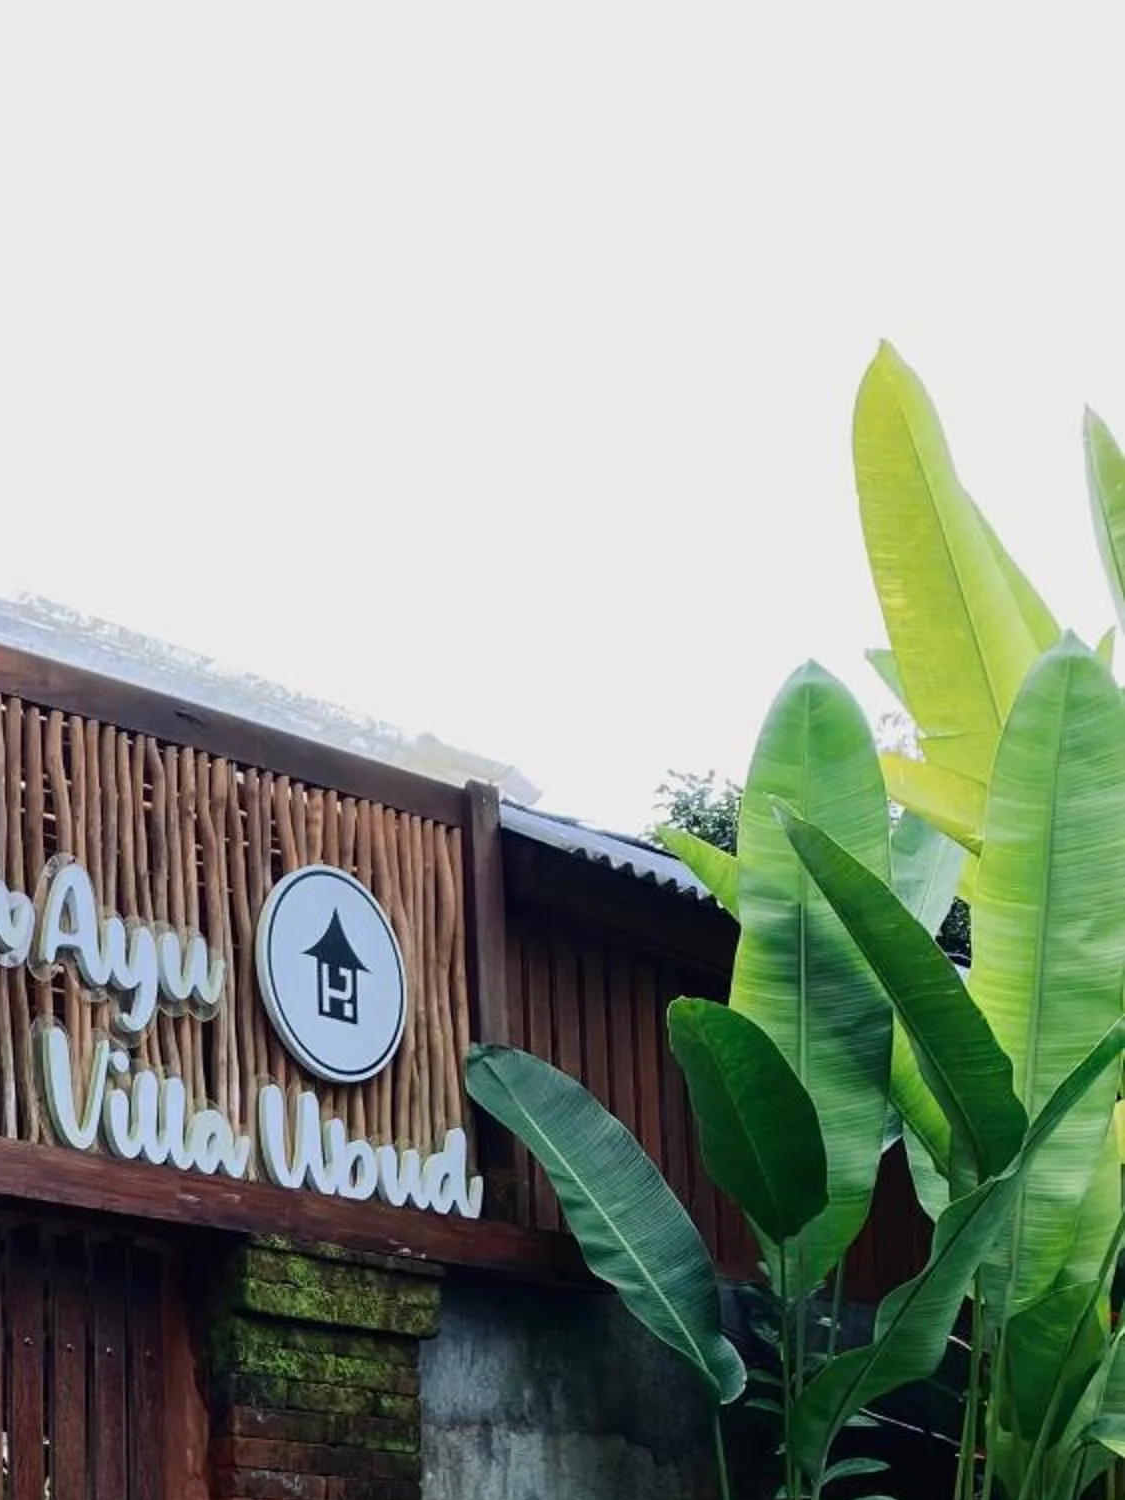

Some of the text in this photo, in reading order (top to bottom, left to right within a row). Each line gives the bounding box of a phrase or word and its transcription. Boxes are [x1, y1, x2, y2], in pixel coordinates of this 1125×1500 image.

[33, 857, 225, 1036] Ayu
[38, 1024, 484, 1219] Villa Ubud
